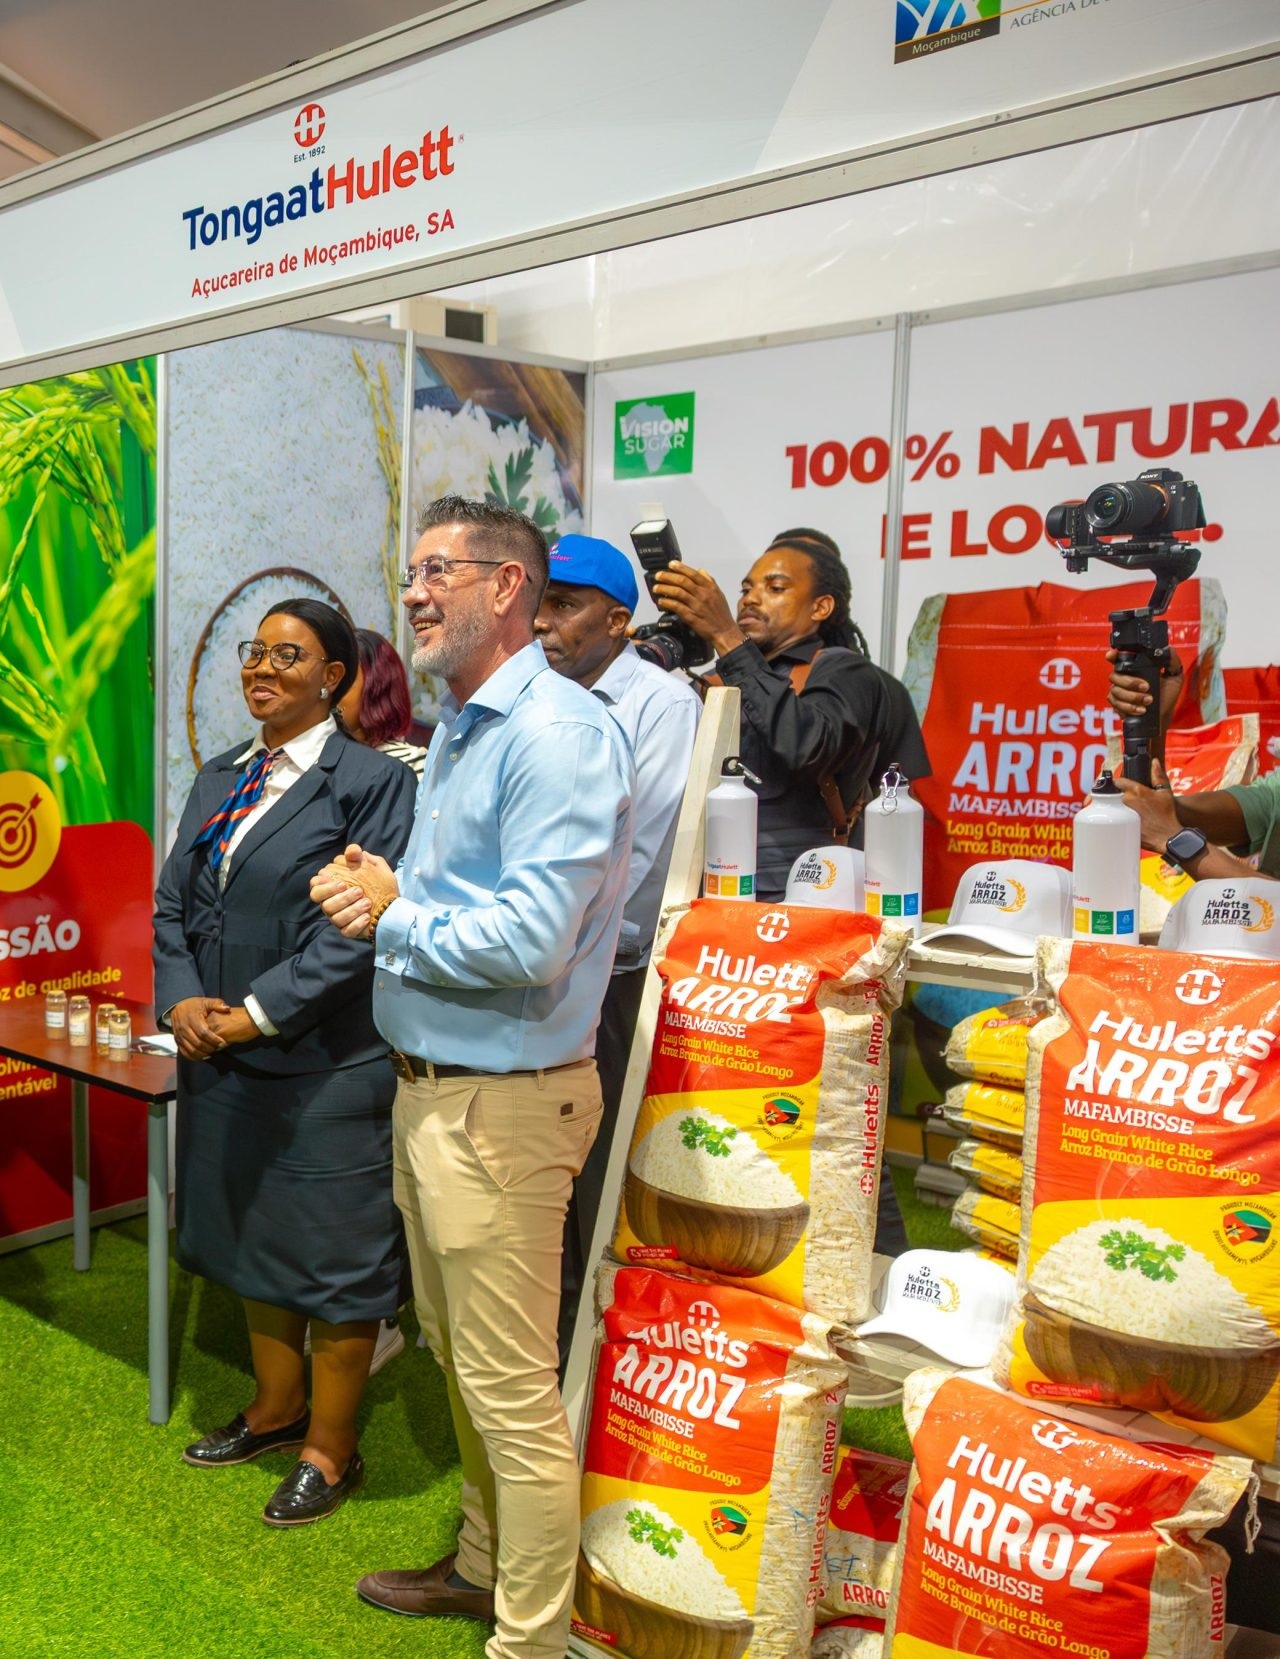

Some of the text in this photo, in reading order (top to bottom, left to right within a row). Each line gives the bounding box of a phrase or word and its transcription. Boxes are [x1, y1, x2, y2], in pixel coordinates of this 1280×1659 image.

[1010, 1, 1076, 29] AGÊNCIA
[912, 26, 981, 55] Moçambique
[293, 145, 326, 163] Est. 1892
[182, 125, 455, 250] TongaatHulett
[191, 208, 455, 298] Açucareira de Moçambique, SA
[620, 416, 689, 440] VISION
[624, 434, 686, 455] SUGAR
[969, 702, 1123, 737] Hulett
[952, 741, 1109, 796] ARRO
[948, 793, 1082, 819] MAFAMBISS
[946, 820, 1073, 841] Long Grain Whit
[947, 838, 1070, 859] Arroz Branco de
[971, 889, 1007, 901] ARROZ
[974, 881, 1006, 891] Huletts
[1207, 899, 1249, 909] Huletts
[1204, 909, 1251, 920] ARROZ
[14, 980, 36, 998] de
[40, 966, 122, 992] qualidade
[664, 1011, 747, 1039] MAFAMBISSE
[1088, 1009, 1277, 1061] Huletts
[679, 1034, 702, 1051] Grain
[703, 1039, 733, 1055] White
[735, 1044, 760, 1060] Rice
[679, 1047, 711, 1065] Branco
[711, 1053, 725, 1067] de
[725, 1057, 755, 1073] Grão
[755, 1061, 794, 1080] Longo
[1065, 1038, 1260, 1124] ARROZ
[861, 1083, 880, 1169] Huletts
[1064, 1098, 1195, 1135] MAFAMBISSE
[1061, 1123, 1214, 1161] Long Grain White Rice
[1060, 1138, 1261, 1187] Arroz Branco de Grão Longo
[904, 1282, 941, 1300] ARROZ
[612, 1343, 746, 1430] ARROZ
[610, 1388, 695, 1439] MAFAMBISSE
[607, 1408, 707, 1463] Long Grain White Rice
[821, 1418, 838, 1475] ARROZ
[605, 1422, 742, 1487] Arroz Branco de Grão Longo
[946, 1435, 1122, 1530] Huletts
[808, 1494, 830, 1583] Huletts
[925, 1477, 1113, 1593] ARROZ
[923, 1537, 1044, 1605] MAFAMBISSE
[843, 1582, 890, 1609] ARRO
[920, 1562, 1064, 1632] Long Grain White Rice
[1210, 1575, 1224, 1642] ARROZ
[920, 1577, 1111, 1659] Arroz Branco de Grão Longo
